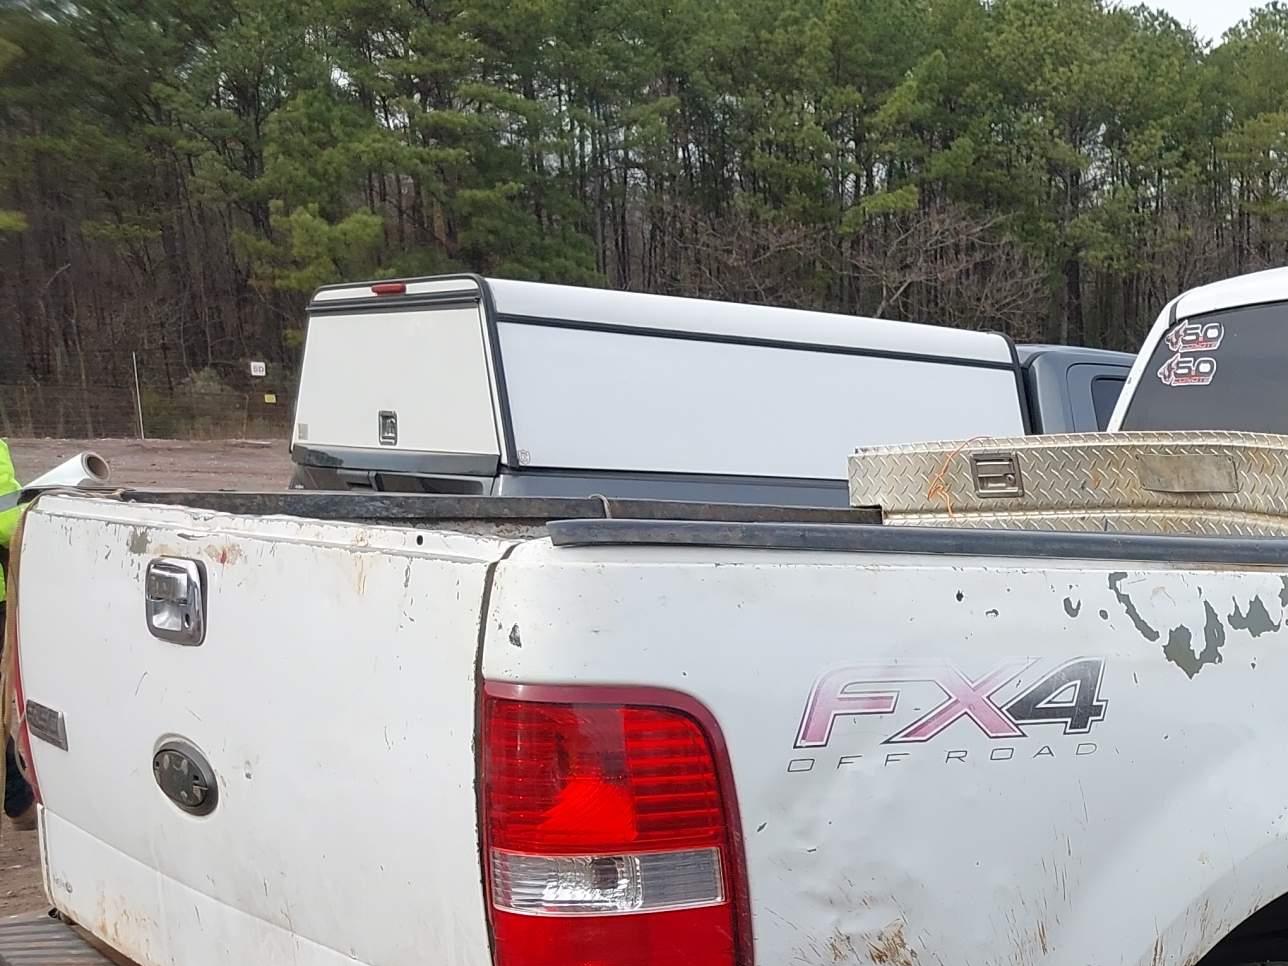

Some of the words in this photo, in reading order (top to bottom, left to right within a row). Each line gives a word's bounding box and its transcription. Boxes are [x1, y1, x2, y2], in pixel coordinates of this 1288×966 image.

[793, 656, 1109, 749] FX4
[787, 753, 912, 773] OFF
[944, 743, 1099, 765] ROAD
